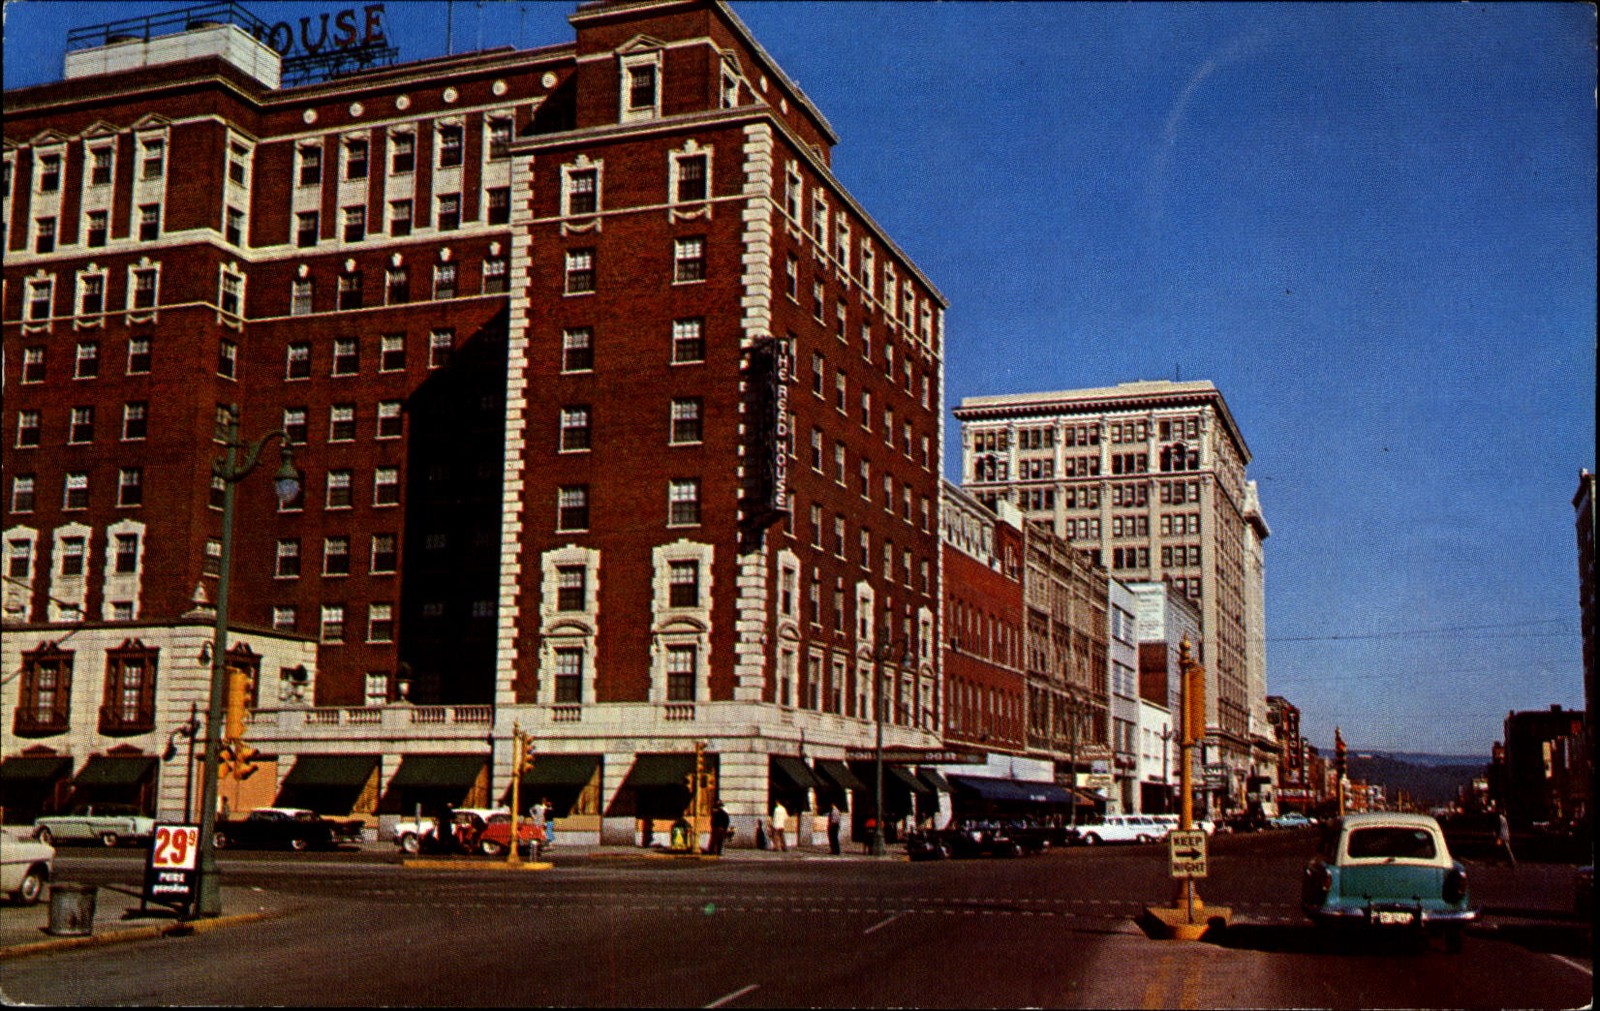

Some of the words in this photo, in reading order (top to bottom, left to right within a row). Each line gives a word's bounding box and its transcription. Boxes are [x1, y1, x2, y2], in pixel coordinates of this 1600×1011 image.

[776, 340, 789, 381] THE
[775, 384, 788, 436] READ
[775, 440, 788, 507] HOUSE
[1288, 712, 1298, 766] TIVOLI
[1173, 836, 1203, 846] KEEP
[1173, 862, 1205, 872] RIGHT
